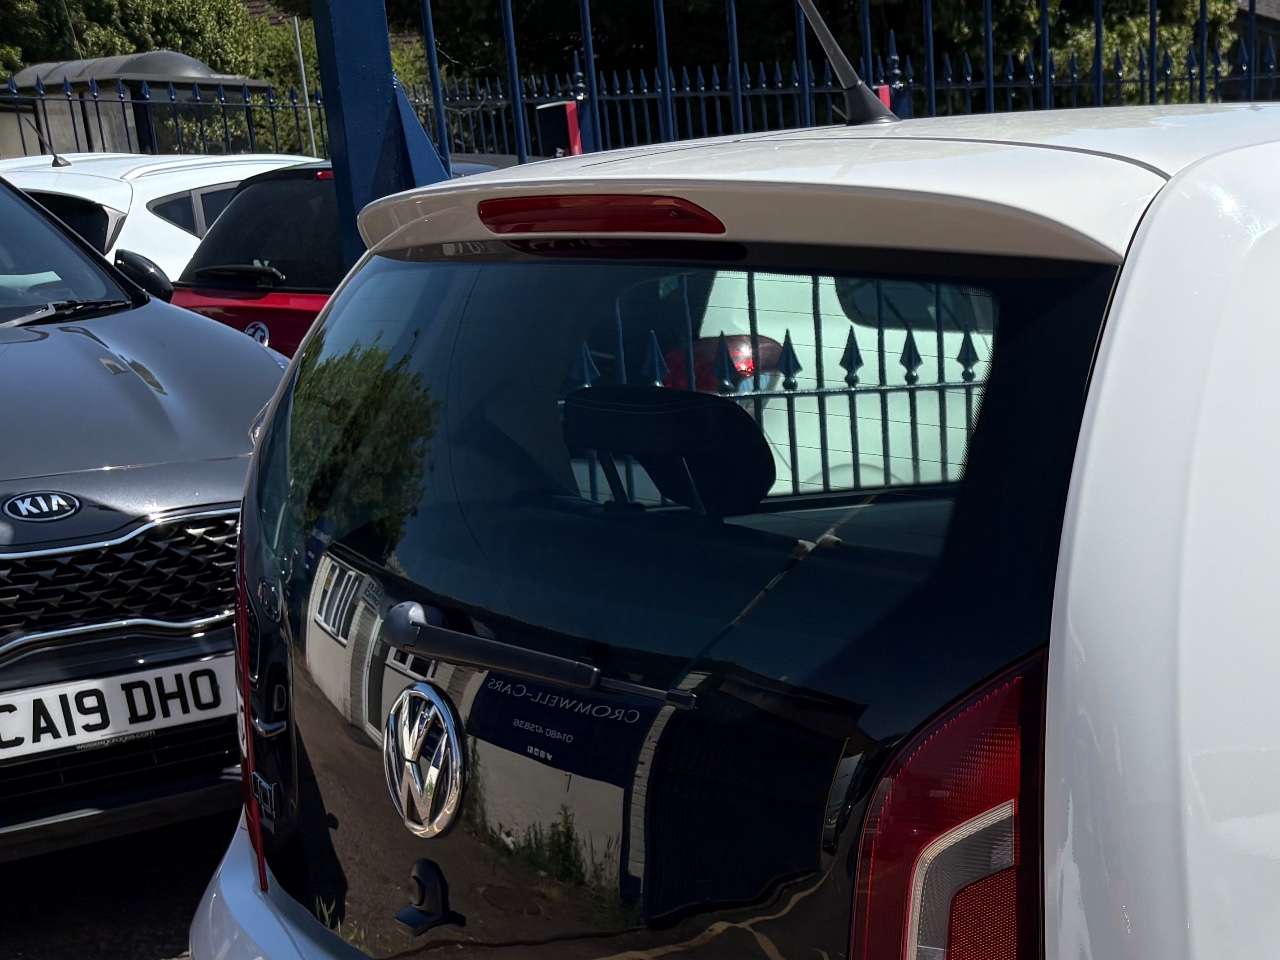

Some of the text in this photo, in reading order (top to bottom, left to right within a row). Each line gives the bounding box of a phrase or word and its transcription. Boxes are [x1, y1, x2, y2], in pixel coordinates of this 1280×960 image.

[14, 494, 70, 516] KIA
[0, 668, 221, 749] CA19 DHO
